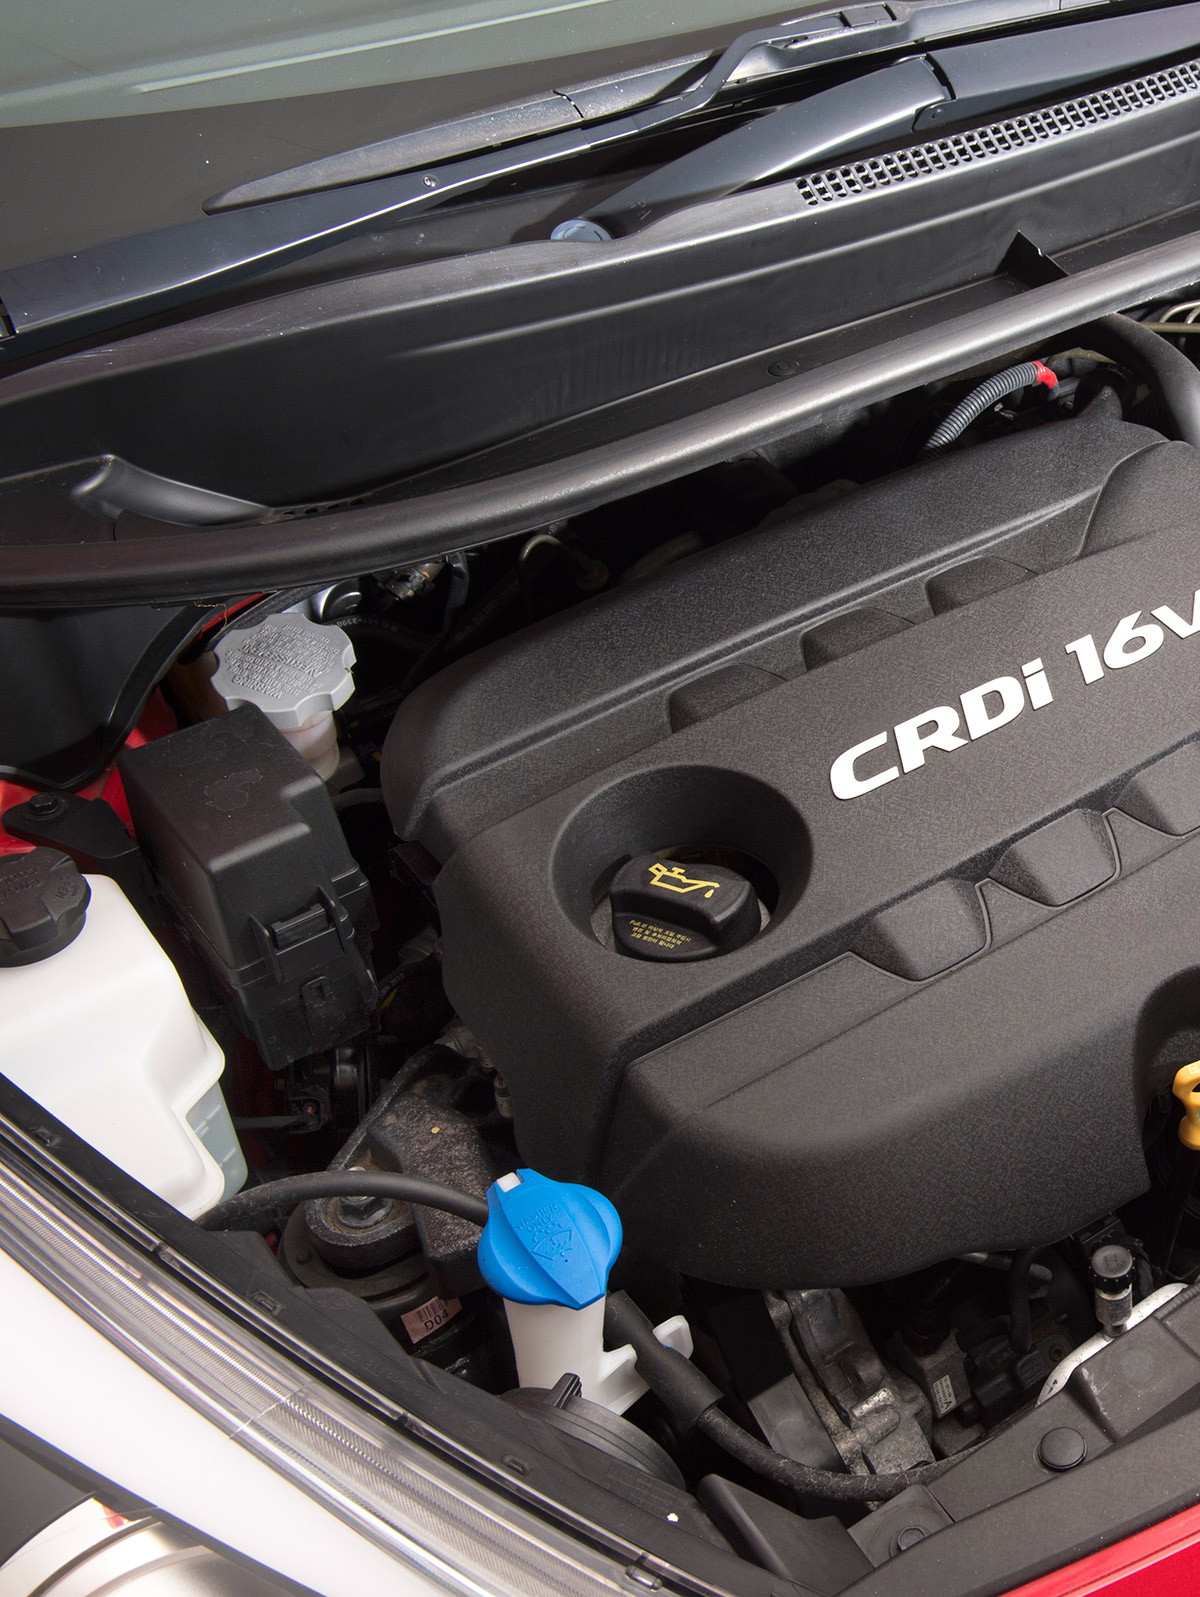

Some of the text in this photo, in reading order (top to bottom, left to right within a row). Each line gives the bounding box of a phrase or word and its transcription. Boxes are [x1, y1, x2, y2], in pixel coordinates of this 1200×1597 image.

[231, 675, 284, 699] WARNING
[829, 657, 1054, 800] CRDi
[424, 1309, 449, 1331] D04
